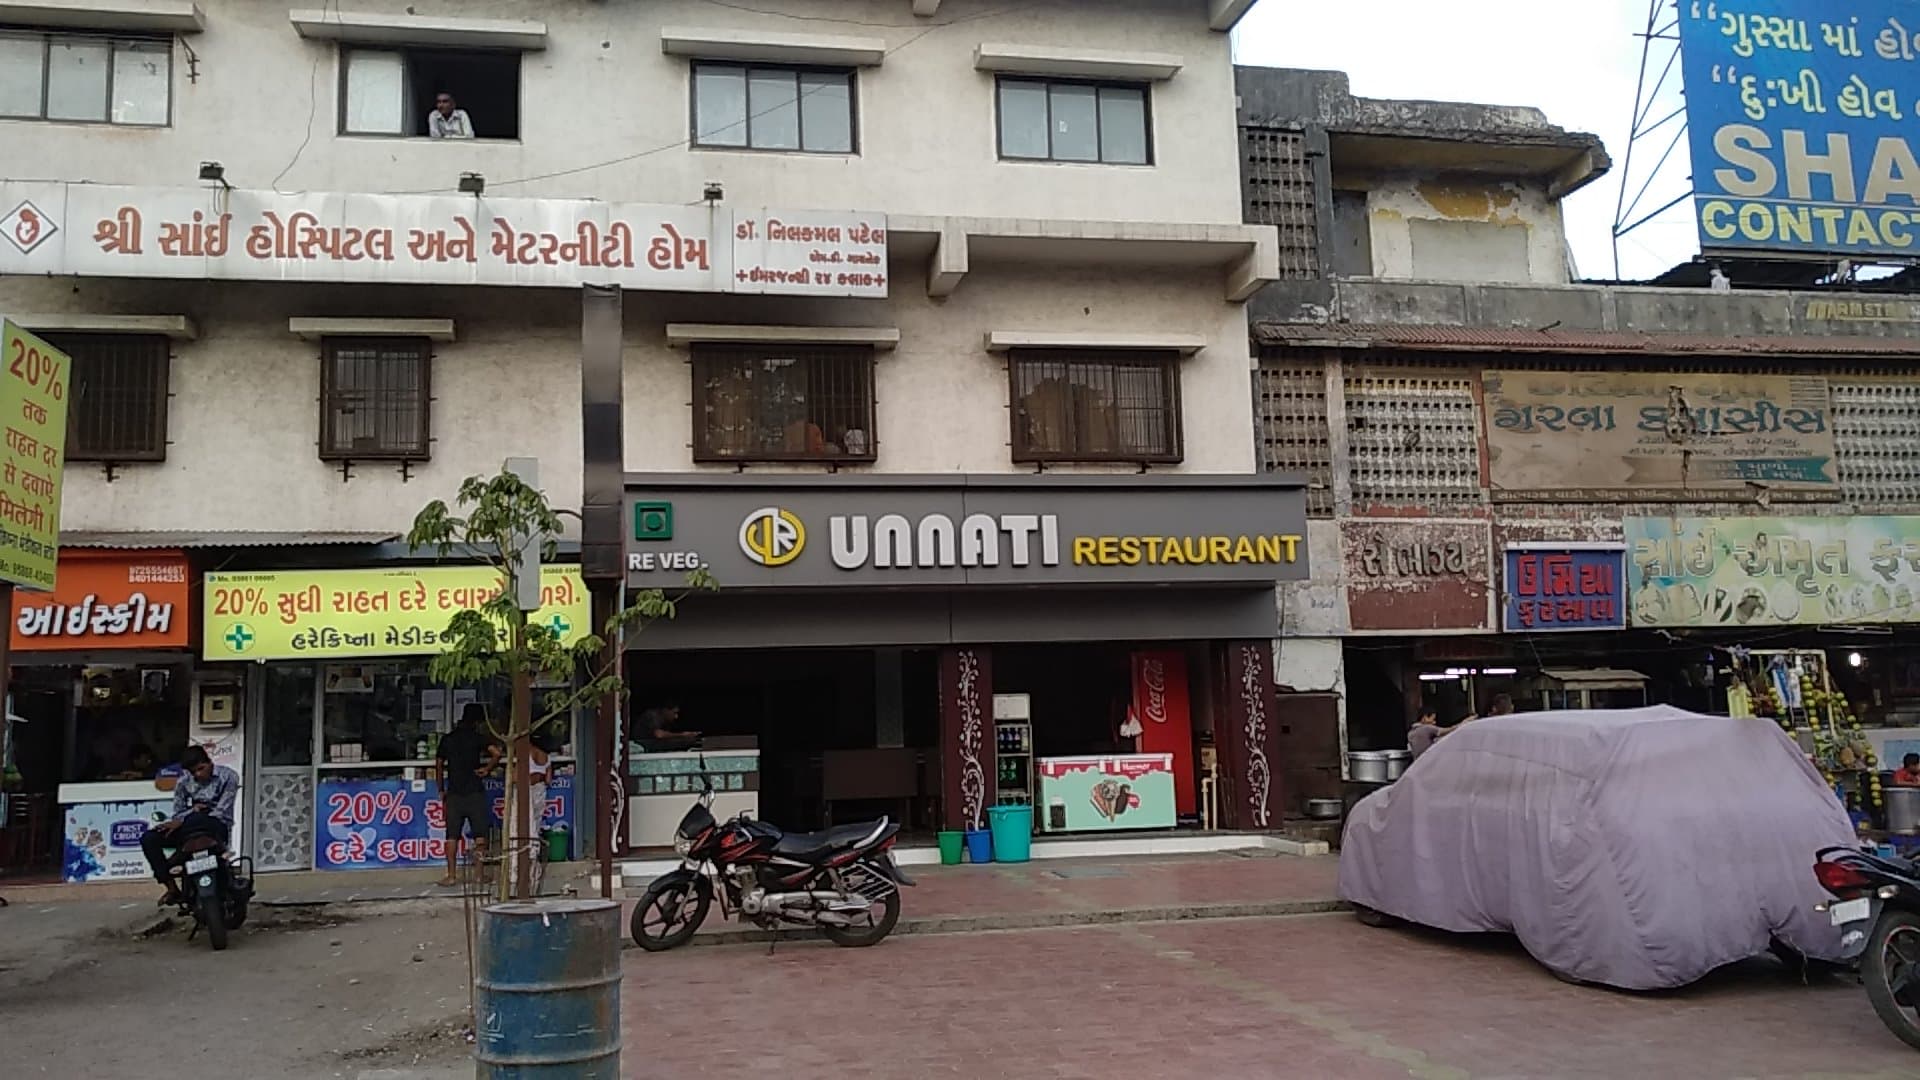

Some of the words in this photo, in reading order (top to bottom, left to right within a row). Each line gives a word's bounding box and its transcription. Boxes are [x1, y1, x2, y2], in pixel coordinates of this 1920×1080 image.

[1822, 17, 1862, 57] માં
[1874, 17, 1920, 62] હો
[1838, 74, 1902, 120] હોવ
[94, 207, 143, 255] શ્રી
[159, 211, 232, 256] સાંઈ
[246, 212, 394, 261] હોસ્પિટલ
[408, 216, 477, 262] અને
[492, 217, 634, 270] મેટરનીટી
[648, 223, 710, 271] હોમ
[767, 219, 841, 243] નિલકમલ
[848, 222, 885, 244] પટેલ
[9, 337, 62, 401] 20%
[23, 399, 48, 425] तक
[6, 426, 37, 459] राहत
[43, 443, 56, 468] दर
[4, 456, 16, 485] से
[659, 553, 709, 570] VEG.
[829, 513, 1059, 569] UNNATI
[1073, 534, 1302, 566] RESTAURANT
[214, 588, 268, 616] 20%
[278, 584, 321, 624] સુધી
[333, 590, 389, 614] રાહત
[399, 580, 427, 611] દરે
[329, 791, 412, 825] 20%
[327, 832, 365, 864] દરે
